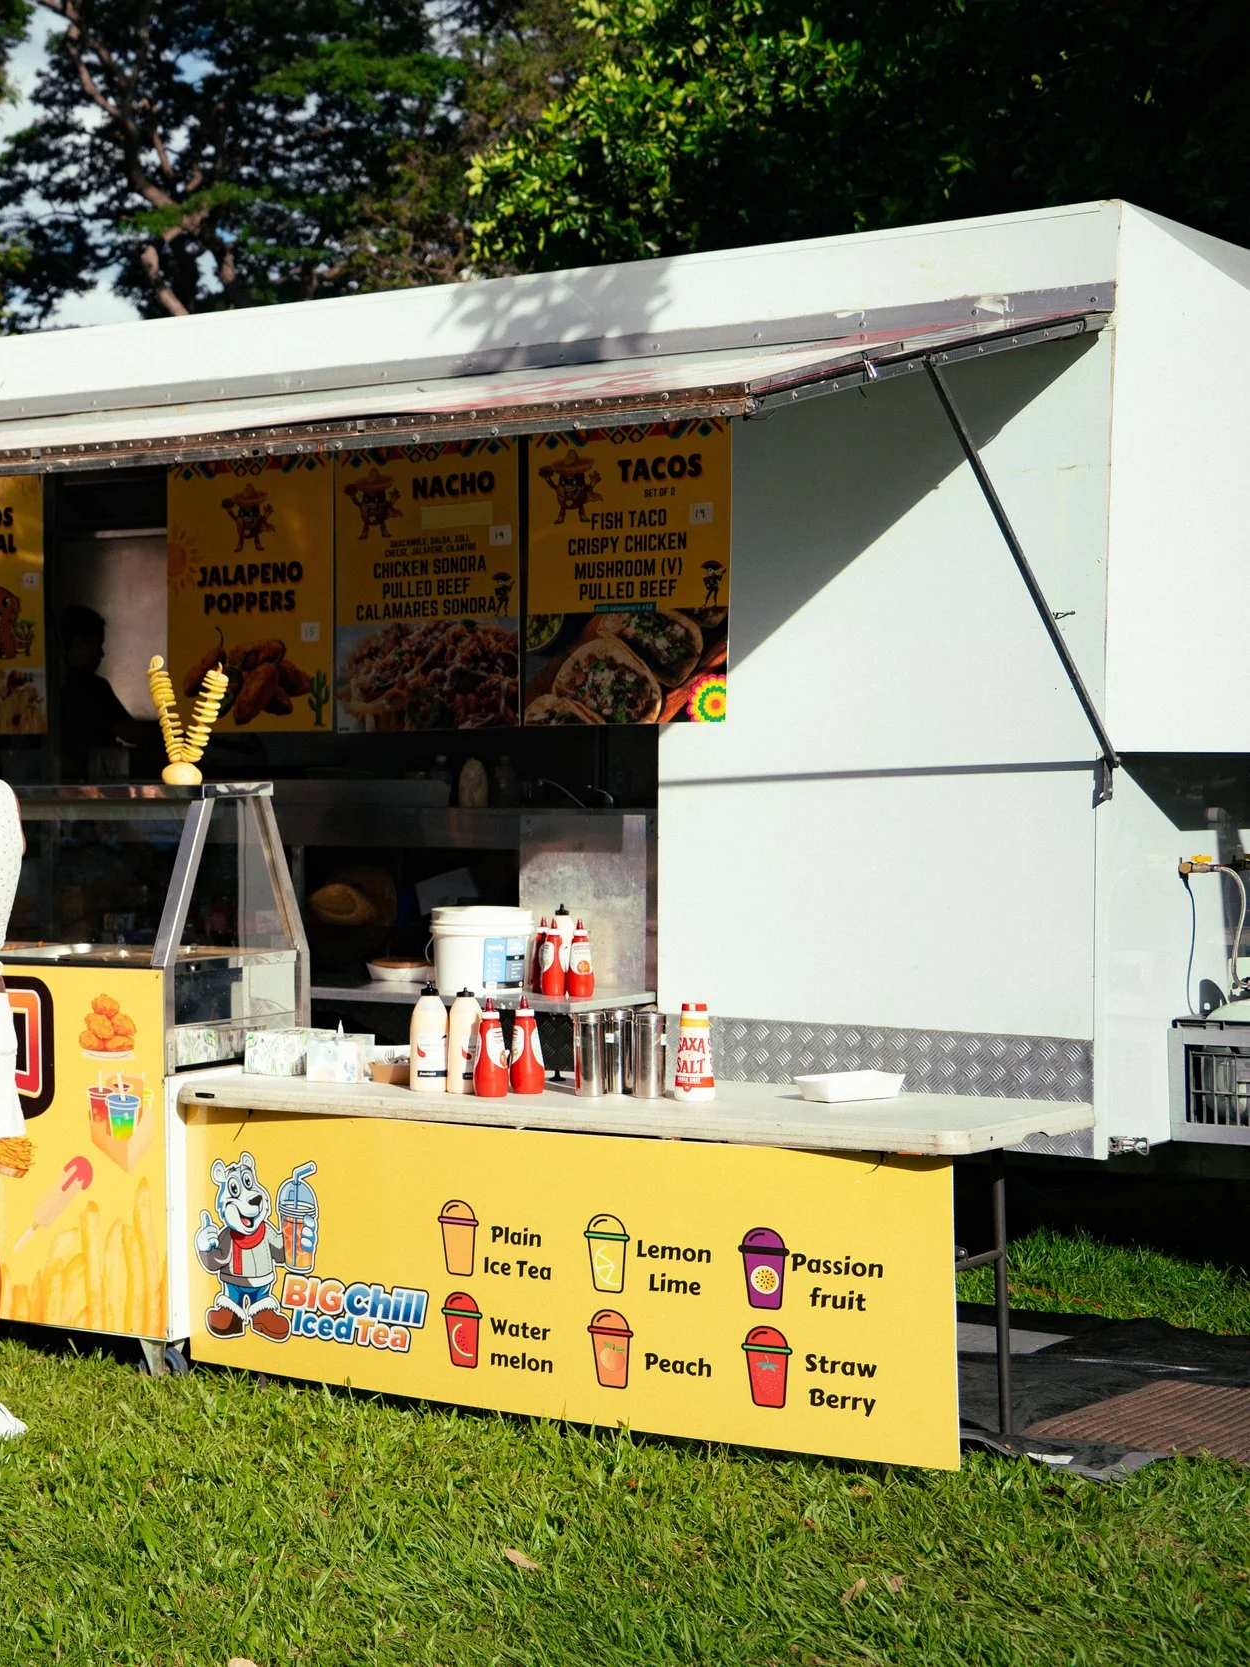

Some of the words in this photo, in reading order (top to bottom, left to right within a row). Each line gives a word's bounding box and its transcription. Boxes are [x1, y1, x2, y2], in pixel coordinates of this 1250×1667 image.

[618, 453, 703, 482] TACOS
[412, 470, 495, 499] NACHO
[644, 488, 653, 498] SET
[659, 487, 668, 497] OF
[670, 487, 676, 496] 2
[591, 512, 623, 531] FISH
[628, 509, 667, 528] TACO
[695, 508, 705, 519] 19
[568, 536, 619, 556] CRISPY
[625, 532, 687, 553] CHICKEN
[197, 561, 303, 588] JALAPENO
[374, 560, 429, 579] CHICKEN
[433, 555, 486, 574] SONORA
[575, 559, 655, 580] MUSHROOM
[661, 557, 683, 577] (V)
[383, 580, 432, 599] PULLED
[437, 577, 470, 596] BEEF
[579, 581, 634, 600] PULLED
[640, 579, 677, 598] BEEF
[204, 590, 296, 615] POPPERS
[356, 600, 439, 621] CALAMARES
[443, 596, 497, 615] SONORA
[677, 1037, 705, 1054] SAXA
[676, 1057, 705, 1074] SALT
[491, 1226, 542, 1248] Plain
[637, 1239, 711, 1263] Lemon
[484, 1256, 511, 1276] Ice
[516, 1260, 551, 1280] Tea
[791, 1253, 883, 1278] Passion
[649, 1273, 701, 1295] Lime
[283, 1274, 345, 1316] BIG
[345, 1283, 428, 1328] Chill
[809, 1287, 866, 1311] fruit
[291, 1309, 354, 1343] Iced
[356, 1319, 411, 1353] Tea
[490, 1317, 551, 1340] Water
[490, 1352, 553, 1373] melon
[644, 1353, 711, 1378] Peach
[805, 1353, 877, 1378] Straw
[809, 1388, 876, 1417] Berry
